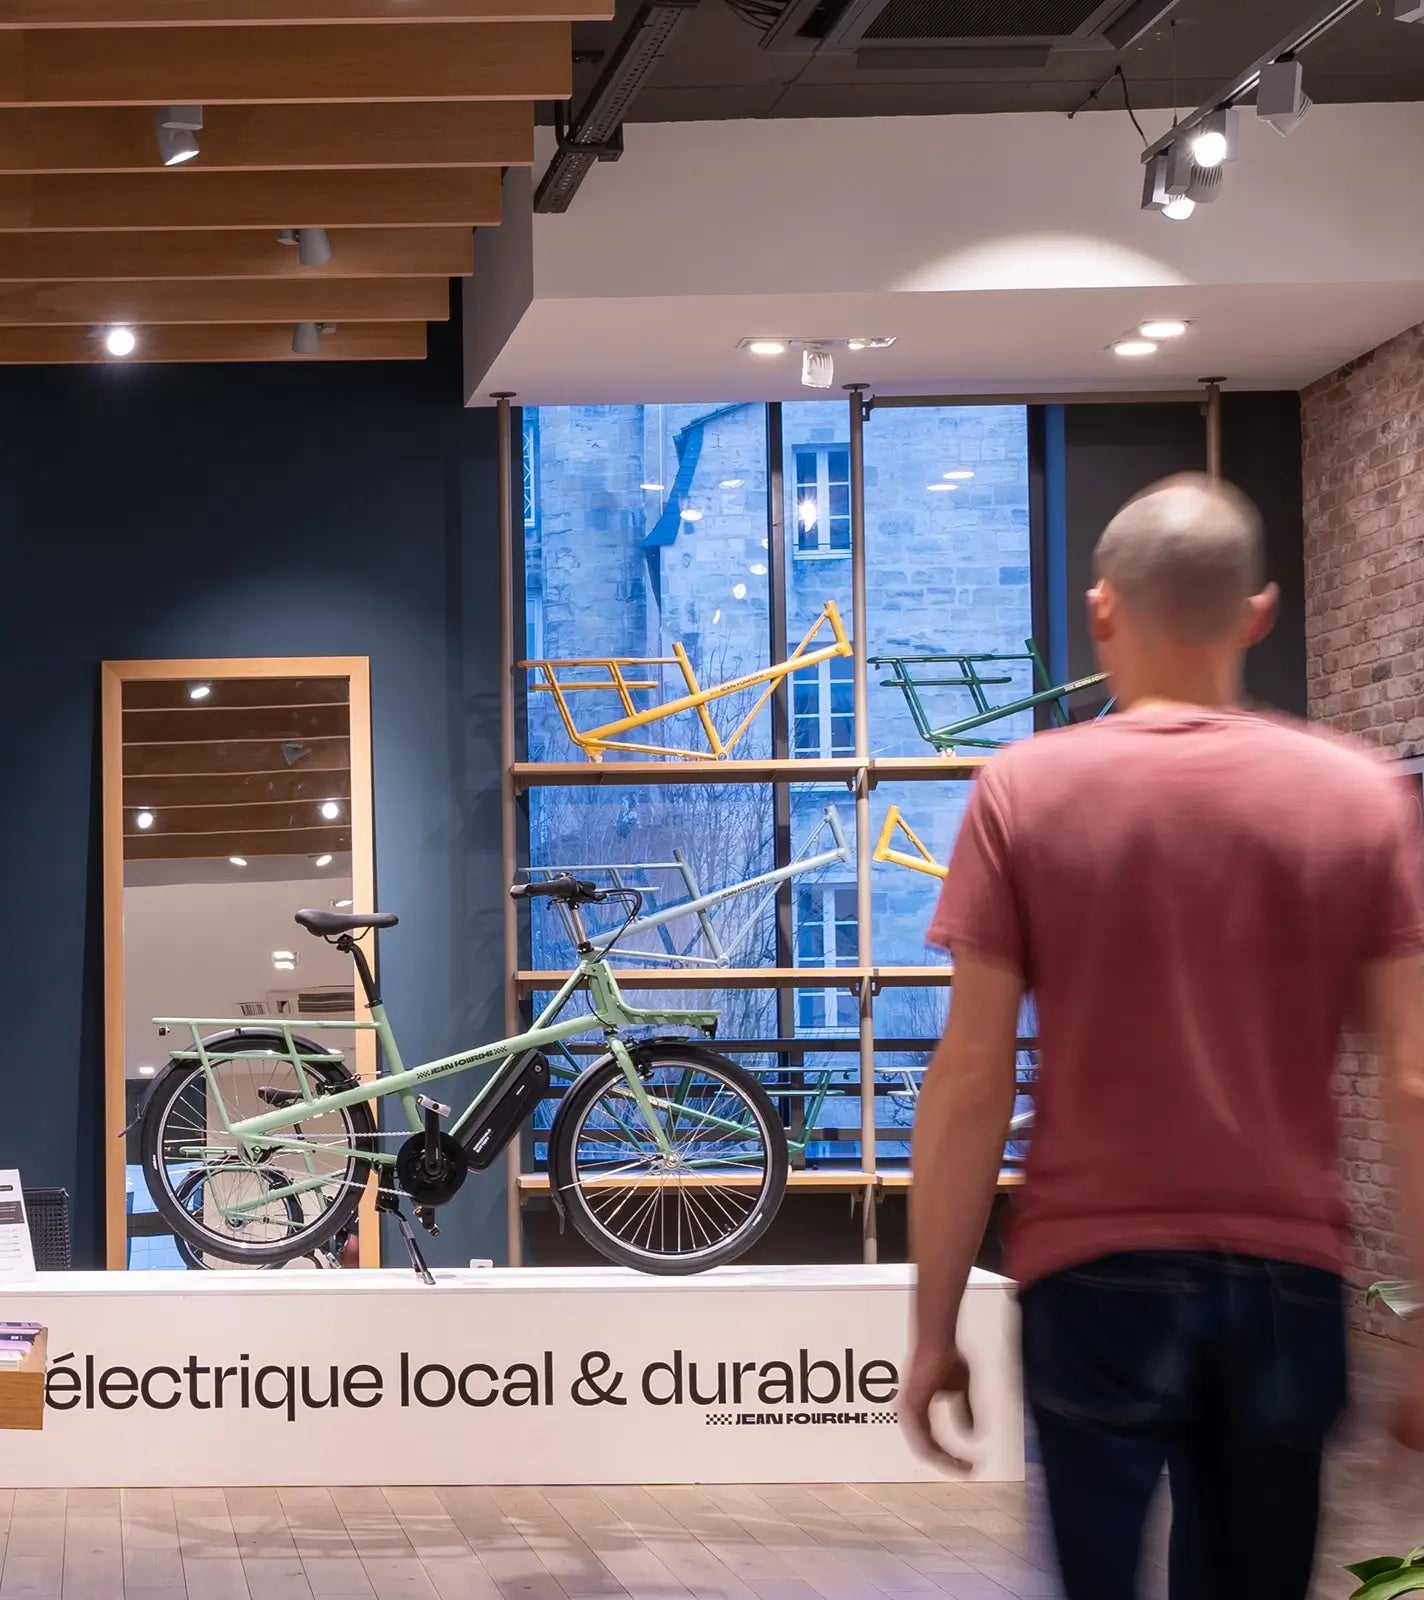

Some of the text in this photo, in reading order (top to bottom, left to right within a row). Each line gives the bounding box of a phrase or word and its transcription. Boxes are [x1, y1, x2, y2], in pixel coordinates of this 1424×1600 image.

[431, 1050, 494, 1075] JEAN FOURCHE
[45, 1347, 900, 1422] électrique local & durable
[735, 1412, 868, 1425] JEAN FOURCHE
